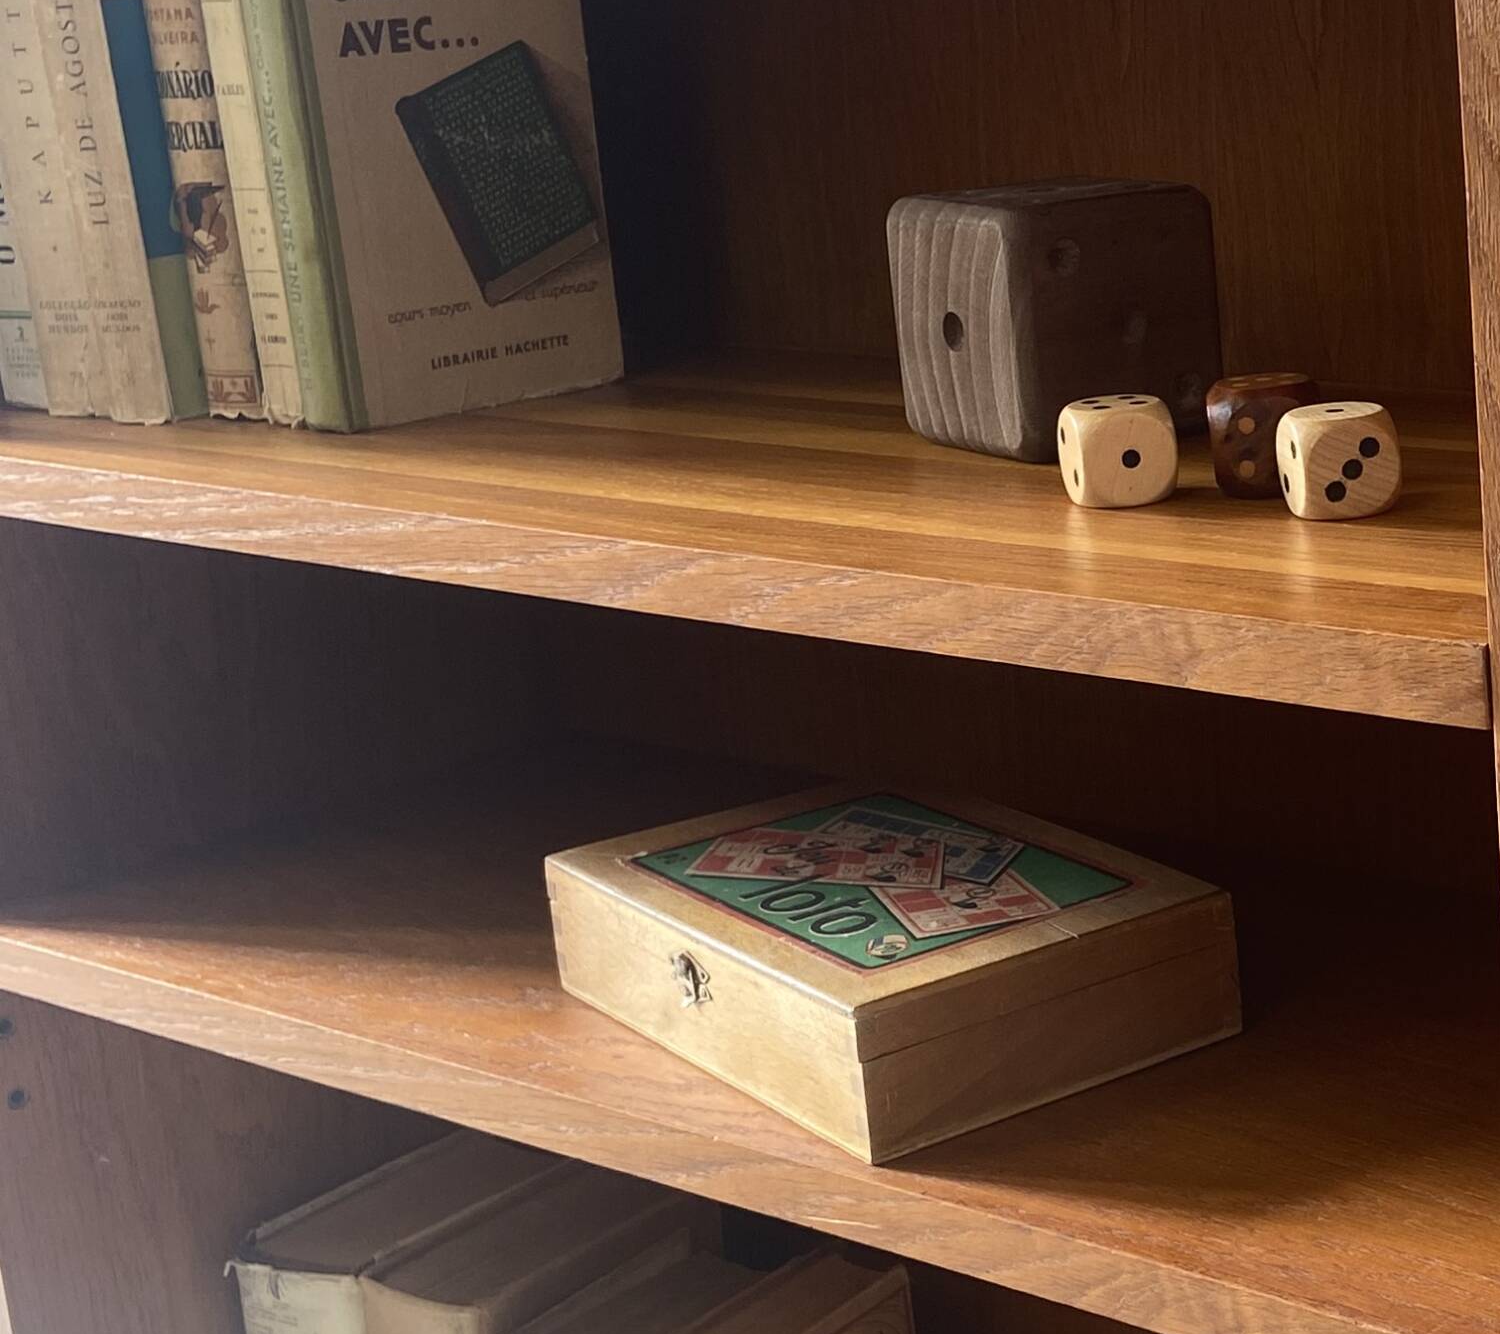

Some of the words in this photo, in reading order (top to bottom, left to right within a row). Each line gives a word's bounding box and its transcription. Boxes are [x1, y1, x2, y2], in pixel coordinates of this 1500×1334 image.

[338, 15, 480, 58] AVEC...
[6, 8, 54, 206] KAPUTT
[74, 117, 98, 154] DE
[84, 170, 110, 227] LUZ
[270, 154, 296, 253] SEMAINE
[284, 261, 303, 304] UNE
[429, 301, 472, 320] moyen
[431, 341, 498, 369] LIBRAIRIE
[504, 334, 570, 358] HACHETTE
[739, 873, 877, 935] loto
